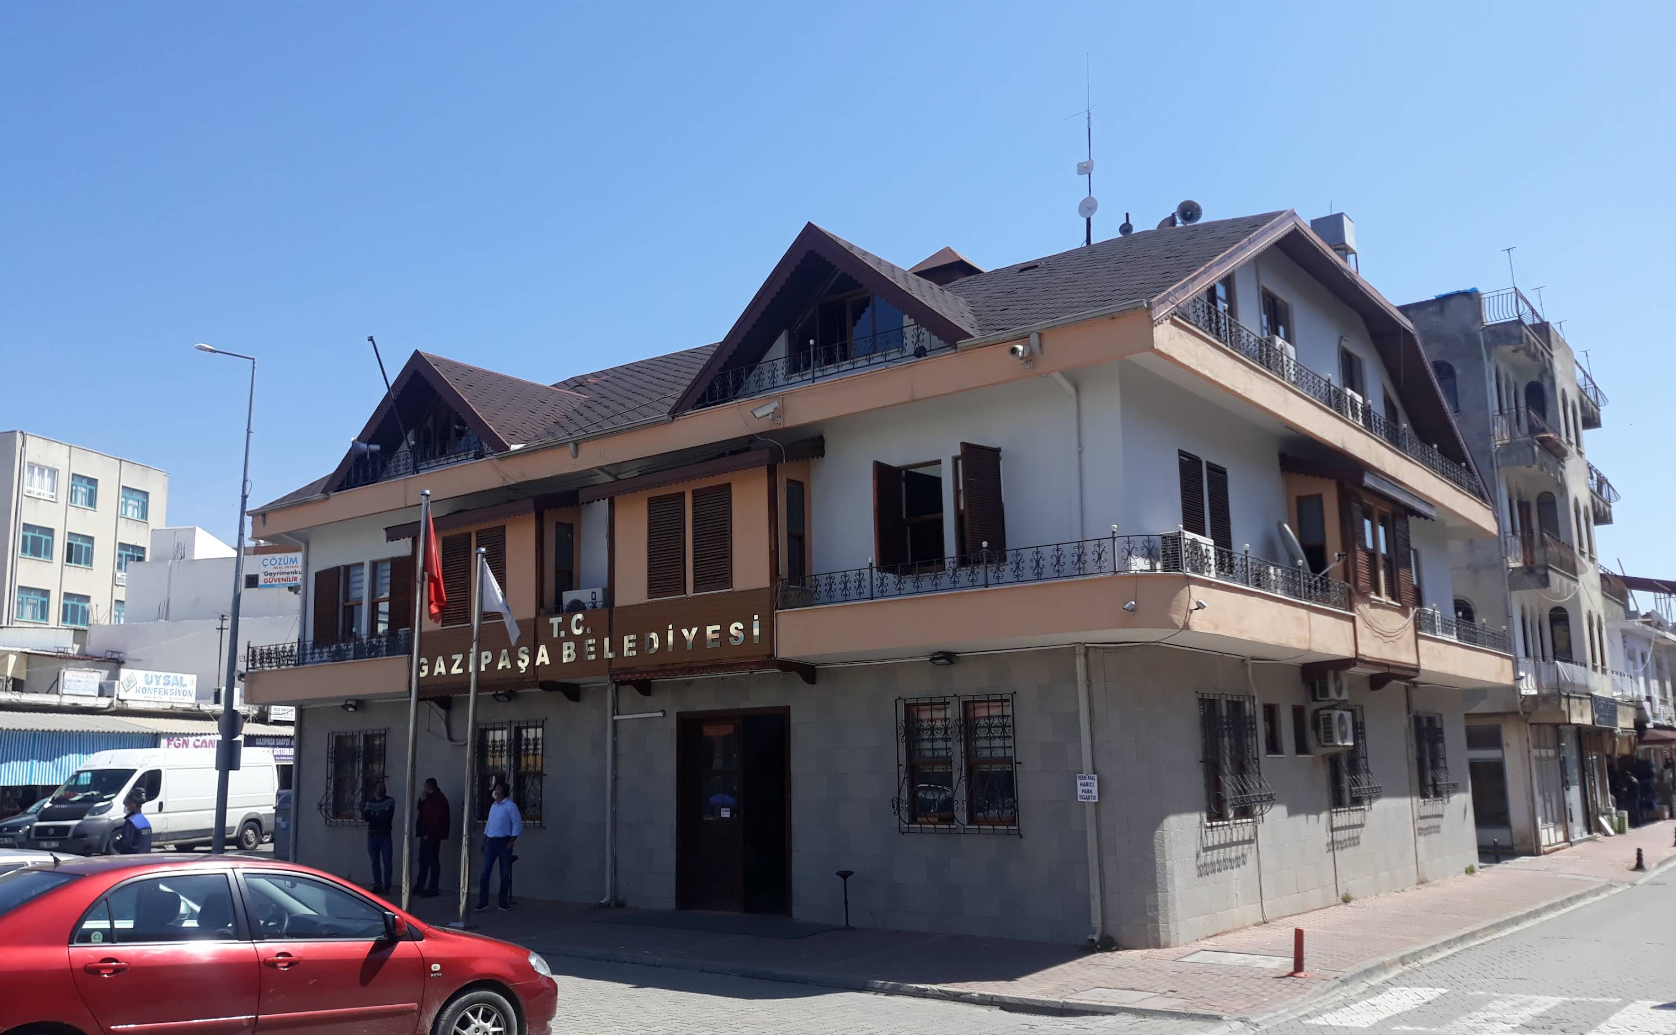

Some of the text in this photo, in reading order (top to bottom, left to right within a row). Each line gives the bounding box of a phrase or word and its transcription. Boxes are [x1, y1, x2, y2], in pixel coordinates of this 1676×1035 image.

[262, 556, 298, 567] ÇÖZÜM
[549, 613, 592, 638] T.C.
[562, 614, 760, 663] BELEDİYESİ
[144, 673, 188, 688] UYSAL
[135, 686, 194, 698] KONFEKSİYON
